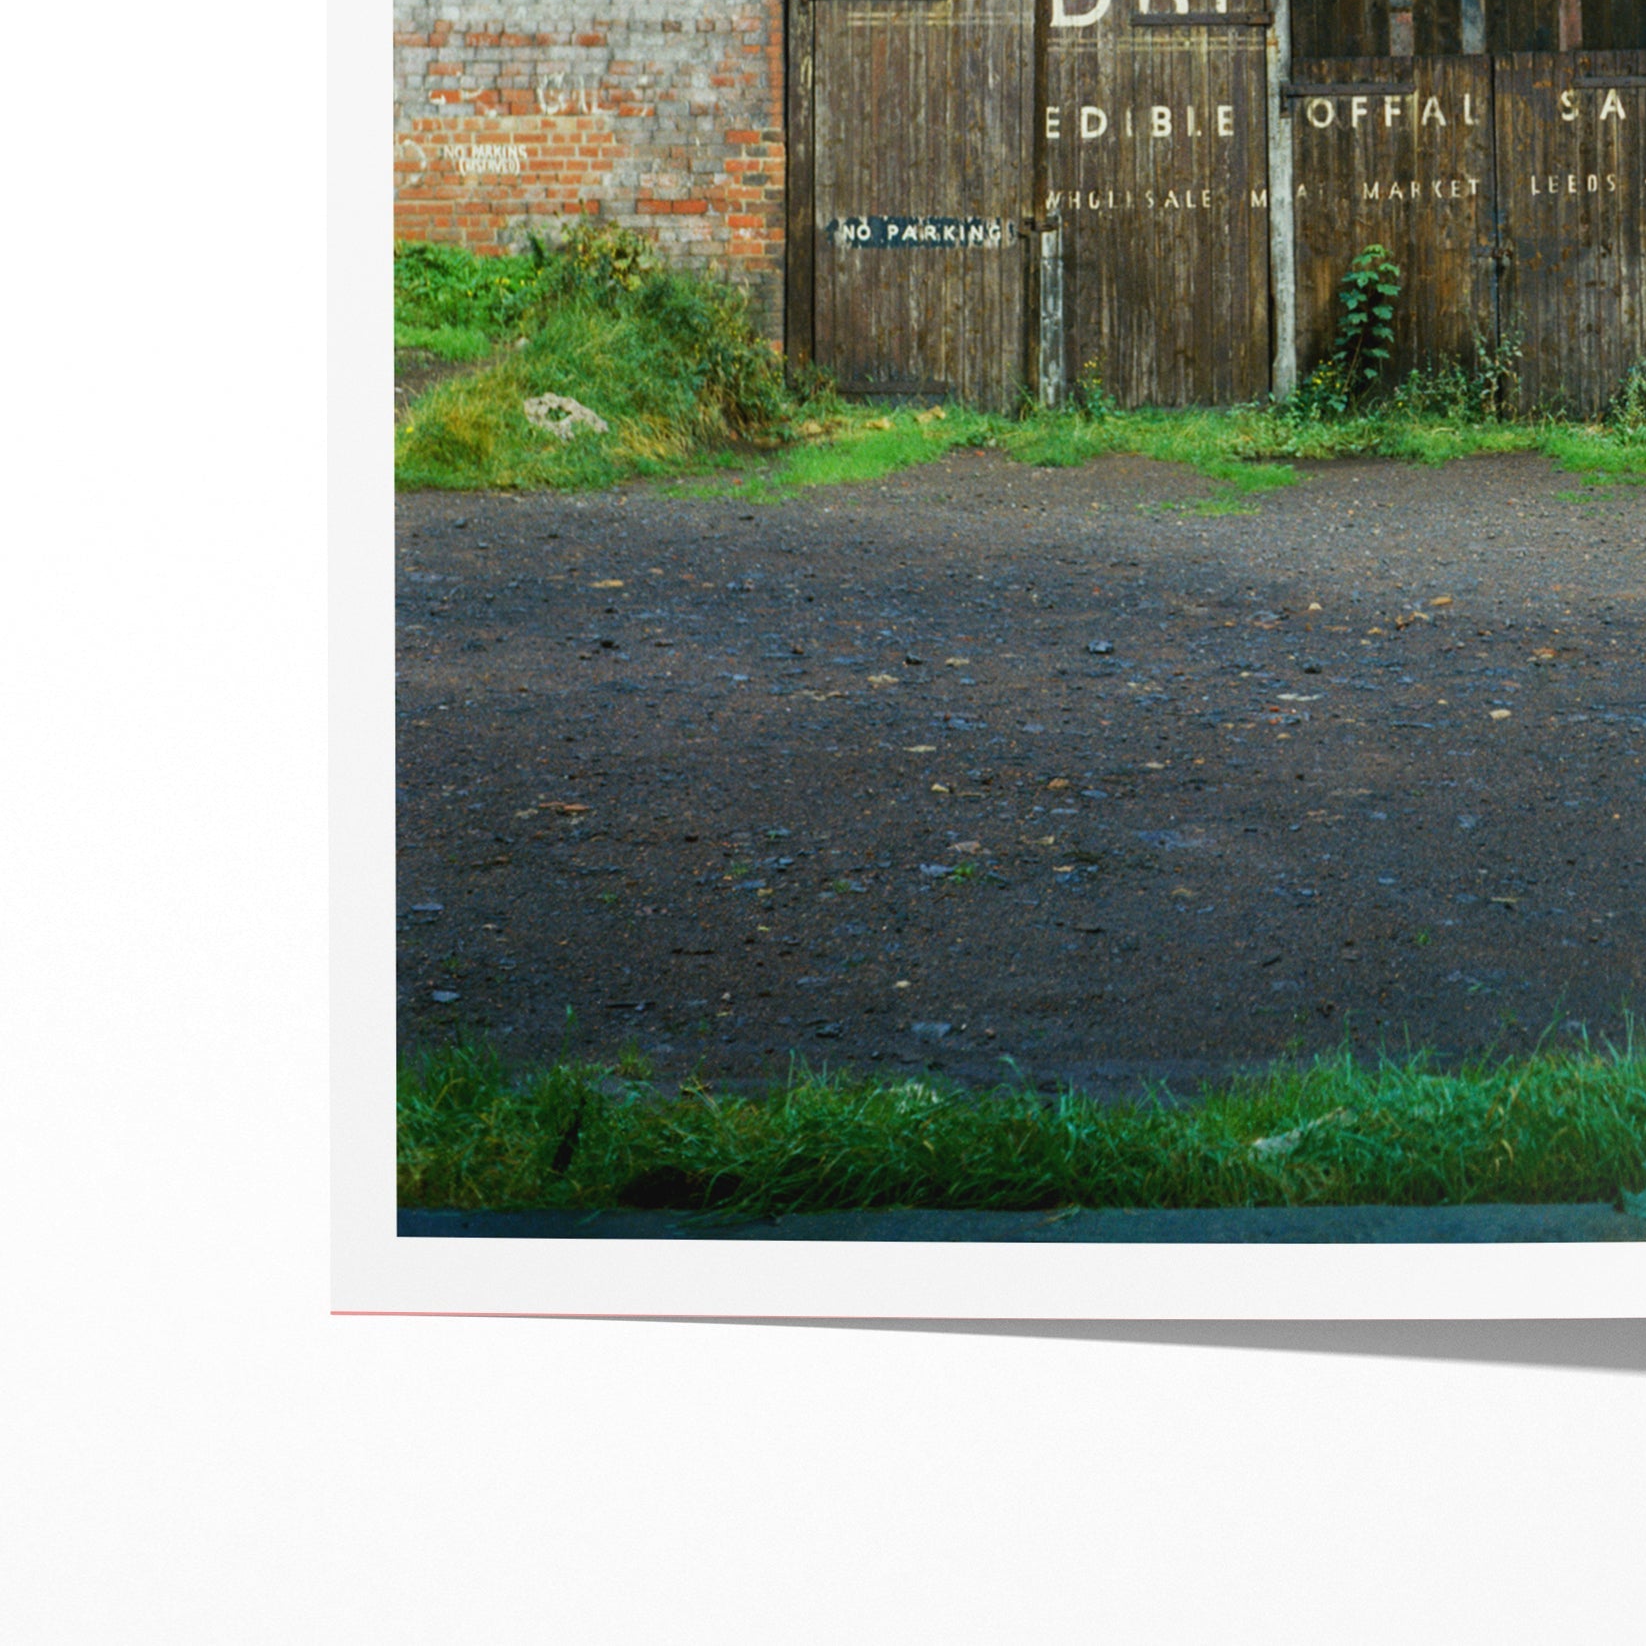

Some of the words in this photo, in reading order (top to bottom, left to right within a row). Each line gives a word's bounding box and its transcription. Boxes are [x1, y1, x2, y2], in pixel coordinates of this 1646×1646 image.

[1046, 105, 1234, 139] EDIBLE
[1306, 93, 1480, 128] OFFAL
[1363, 179, 1480, 200] MARKET
[843, 224, 872, 241] NO
[887, 224, 1002, 241] PARKING
